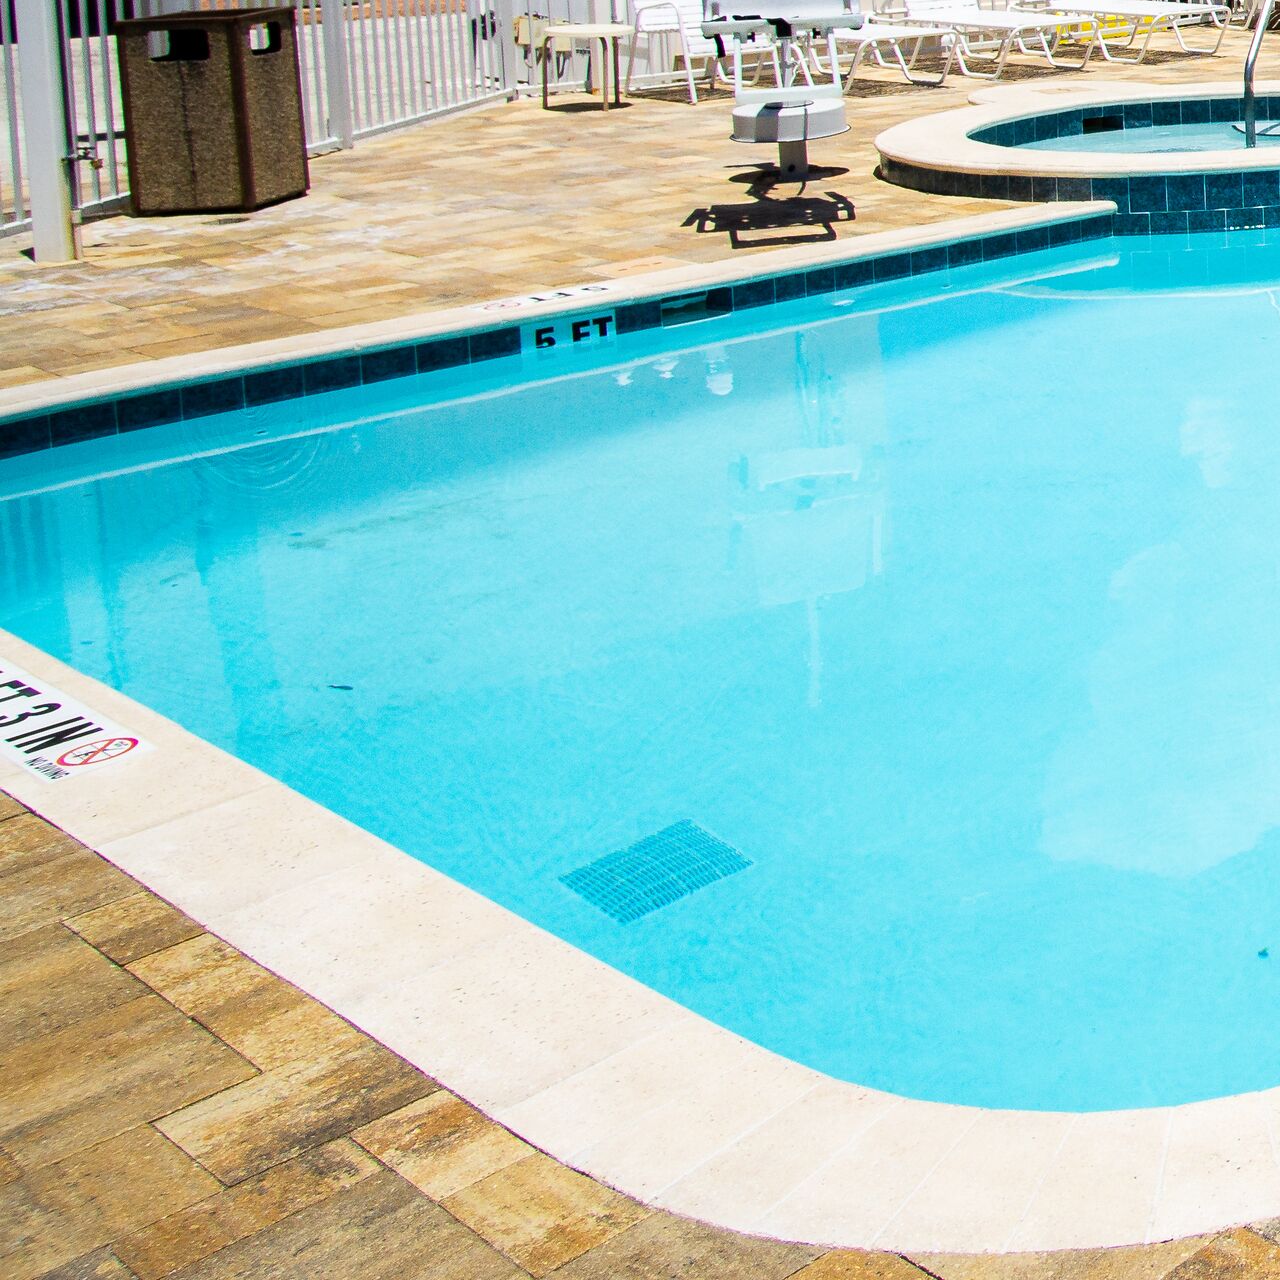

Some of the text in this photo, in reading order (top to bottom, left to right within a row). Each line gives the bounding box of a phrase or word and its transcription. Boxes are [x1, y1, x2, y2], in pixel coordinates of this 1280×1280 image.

[535, 315, 614, 349] 5 FT
[4, 715, 105, 755] IN
[24, 756, 70, 781] NO DIVING
